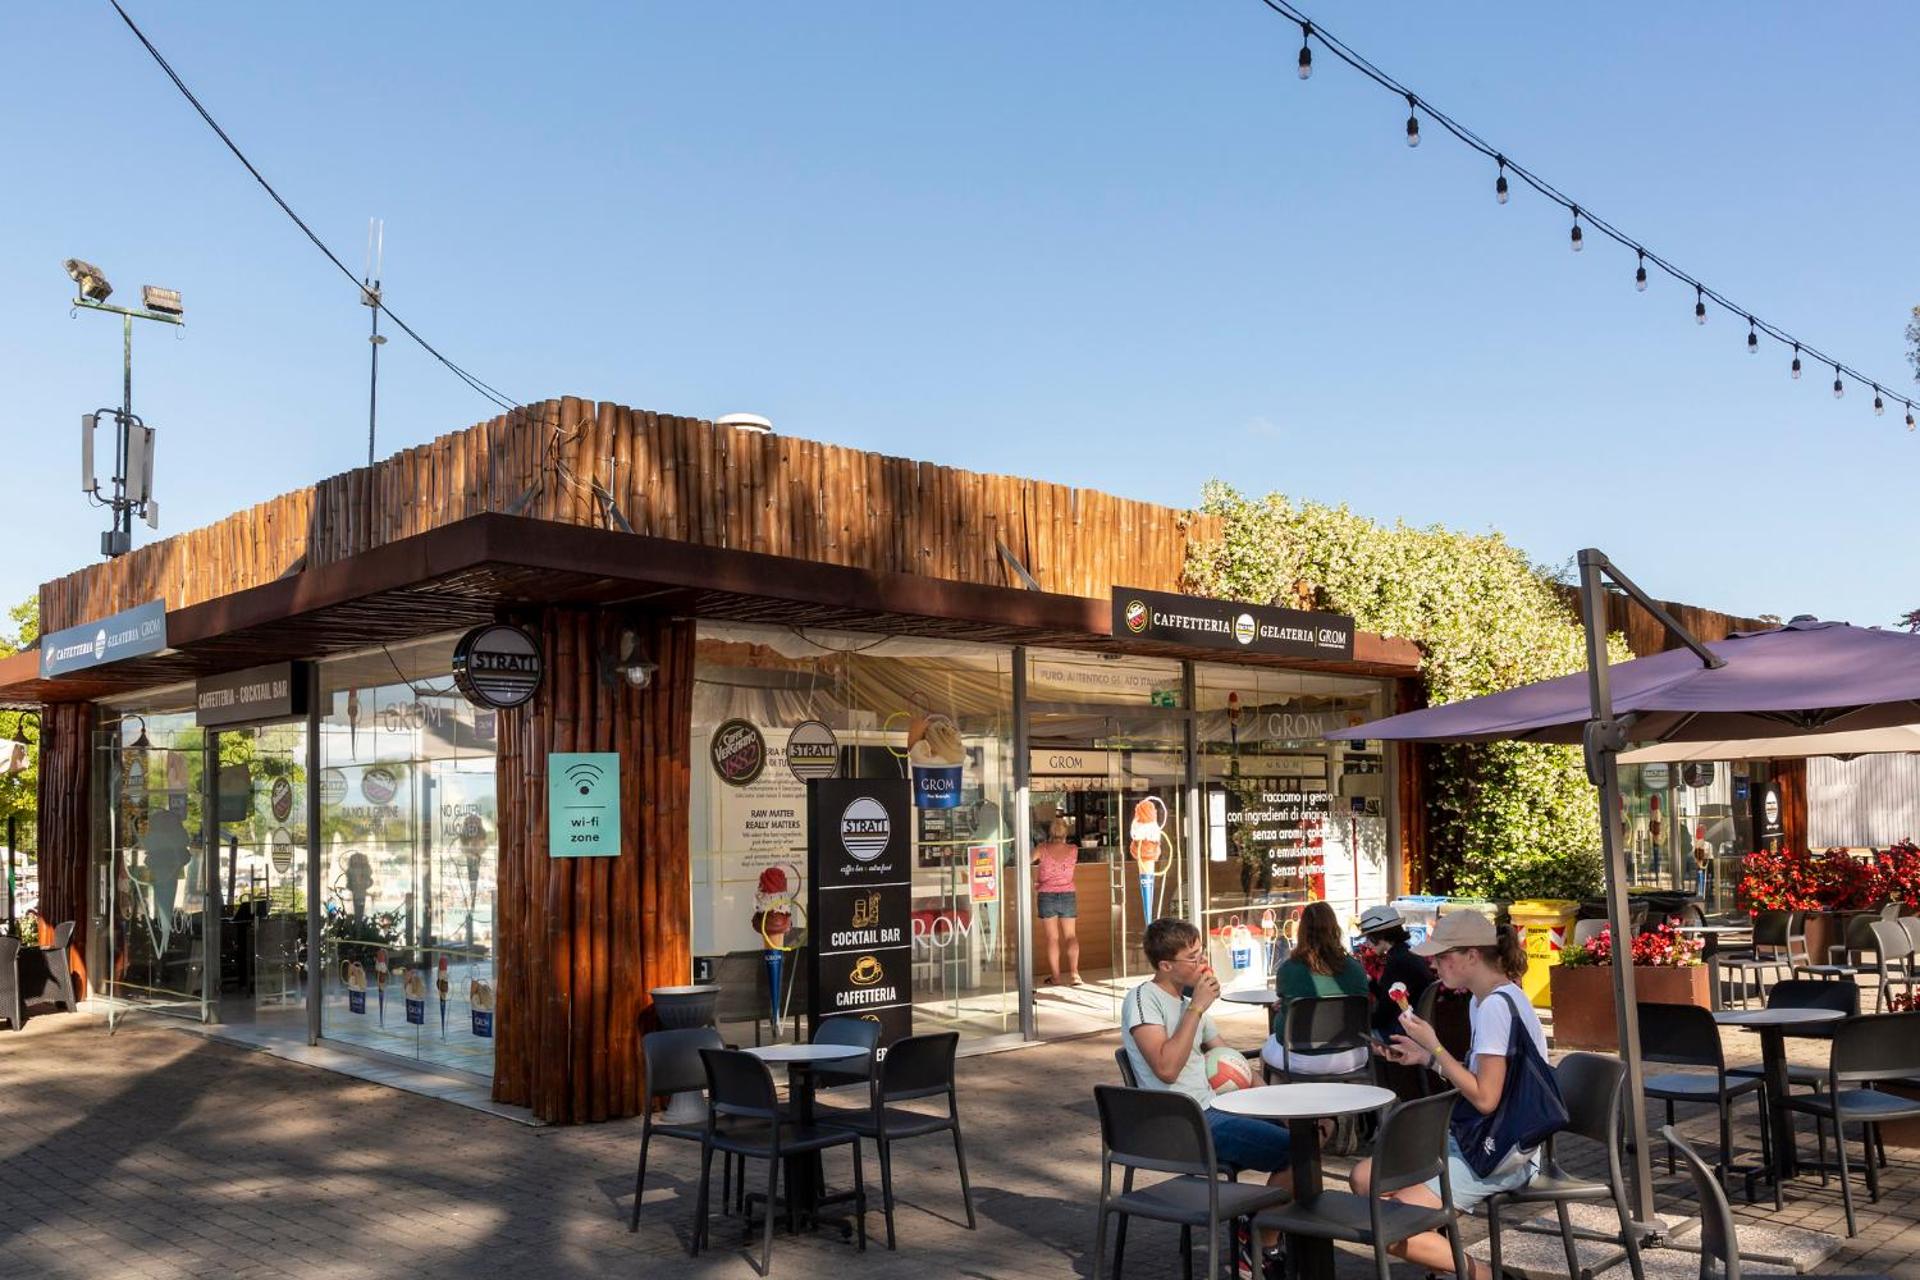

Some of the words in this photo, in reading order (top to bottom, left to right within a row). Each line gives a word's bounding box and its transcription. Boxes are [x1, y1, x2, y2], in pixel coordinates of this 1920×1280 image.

[1153, 612, 1231, 634] CAFFETTERIA
[1260, 625, 1314, 642] GELATERIA
[1319, 629, 1346, 644] GROM
[56, 642, 93, 661] CAFFETTERIA
[476, 653, 534, 672] STRATI
[199, 688, 235, 710] CAFFETTERIA
[240, 682, 272, 704] COCKTAIL
[273, 680, 288, 699] BAR
[384, 702, 441, 732] GROM
[1268, 713, 1323, 738] GROM
[793, 744, 833, 757] STRATI
[1049, 756, 1083, 769] GROM
[921, 778, 955, 791] GROM
[571, 816, 599, 827] wi-fi
[750, 809, 768, 818] RAW
[768, 809, 795, 818] MATTER
[1227, 812, 1243, 822] con
[1245, 807, 1289, 825] ingredienti
[1290, 805, 1300, 821] di
[745, 820, 769, 829] REALLY
[771, 820, 801, 829] MATTERS
[846, 819, 885, 833] STRATI
[570, 833, 600, 843] zone
[1252, 830, 1279, 841] senza
[1271, 863, 1297, 877] Senza
[831, 930, 879, 947] COCKTAIL
[881, 928, 901, 943] BAR
[912, 916, 977, 948] ROM
[836, 986, 897, 1007] CAFFETTERIA
